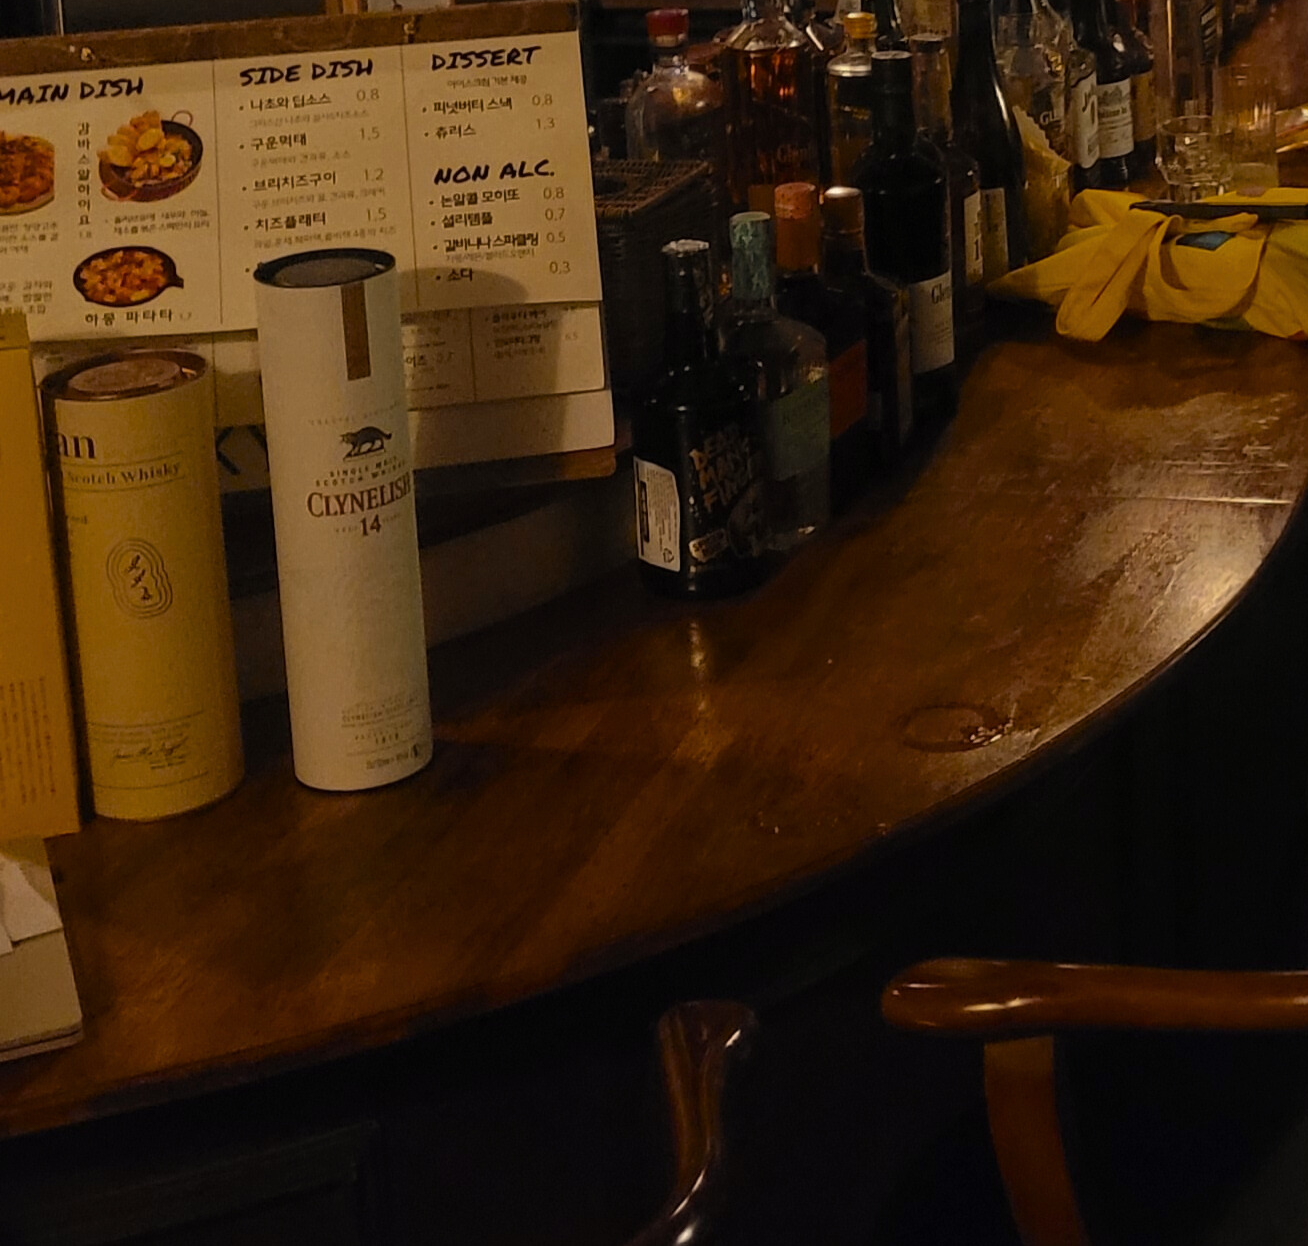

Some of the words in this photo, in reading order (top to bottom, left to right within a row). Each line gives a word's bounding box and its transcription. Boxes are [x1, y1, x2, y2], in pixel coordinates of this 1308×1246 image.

[431, 45, 542, 71] DISSERT
[239, 64, 302, 87] SIDE
[311, 58, 373, 80] DISH
[0, 84, 69, 105] MAIN
[80, 77, 143, 100] DISH
[356, 88, 380, 101] 0.8
[250, 96, 289, 111] 나초와
[293, 92, 332, 109] 딥소스
[531, 94, 553, 107] 0.8
[536, 117, 555, 130] 1.3
[359, 127, 380, 141] 1.5
[364, 168, 384, 182] 1.2
[433, 164, 490, 185] NON
[499, 158, 555, 180] ALC.
[253, 170, 336, 192] 브리치즈구이
[543, 187, 565, 200] 0.8
[366, 207, 387, 222] 1.5
[544, 208, 565, 222] 0.7
[546, 231, 566, 244] 0.5
[448, 267, 474, 282] 소다
[549, 261, 571, 275] 0.3
[306, 471, 411, 518] CLYNELISH
[360, 514, 382, 536] 14
